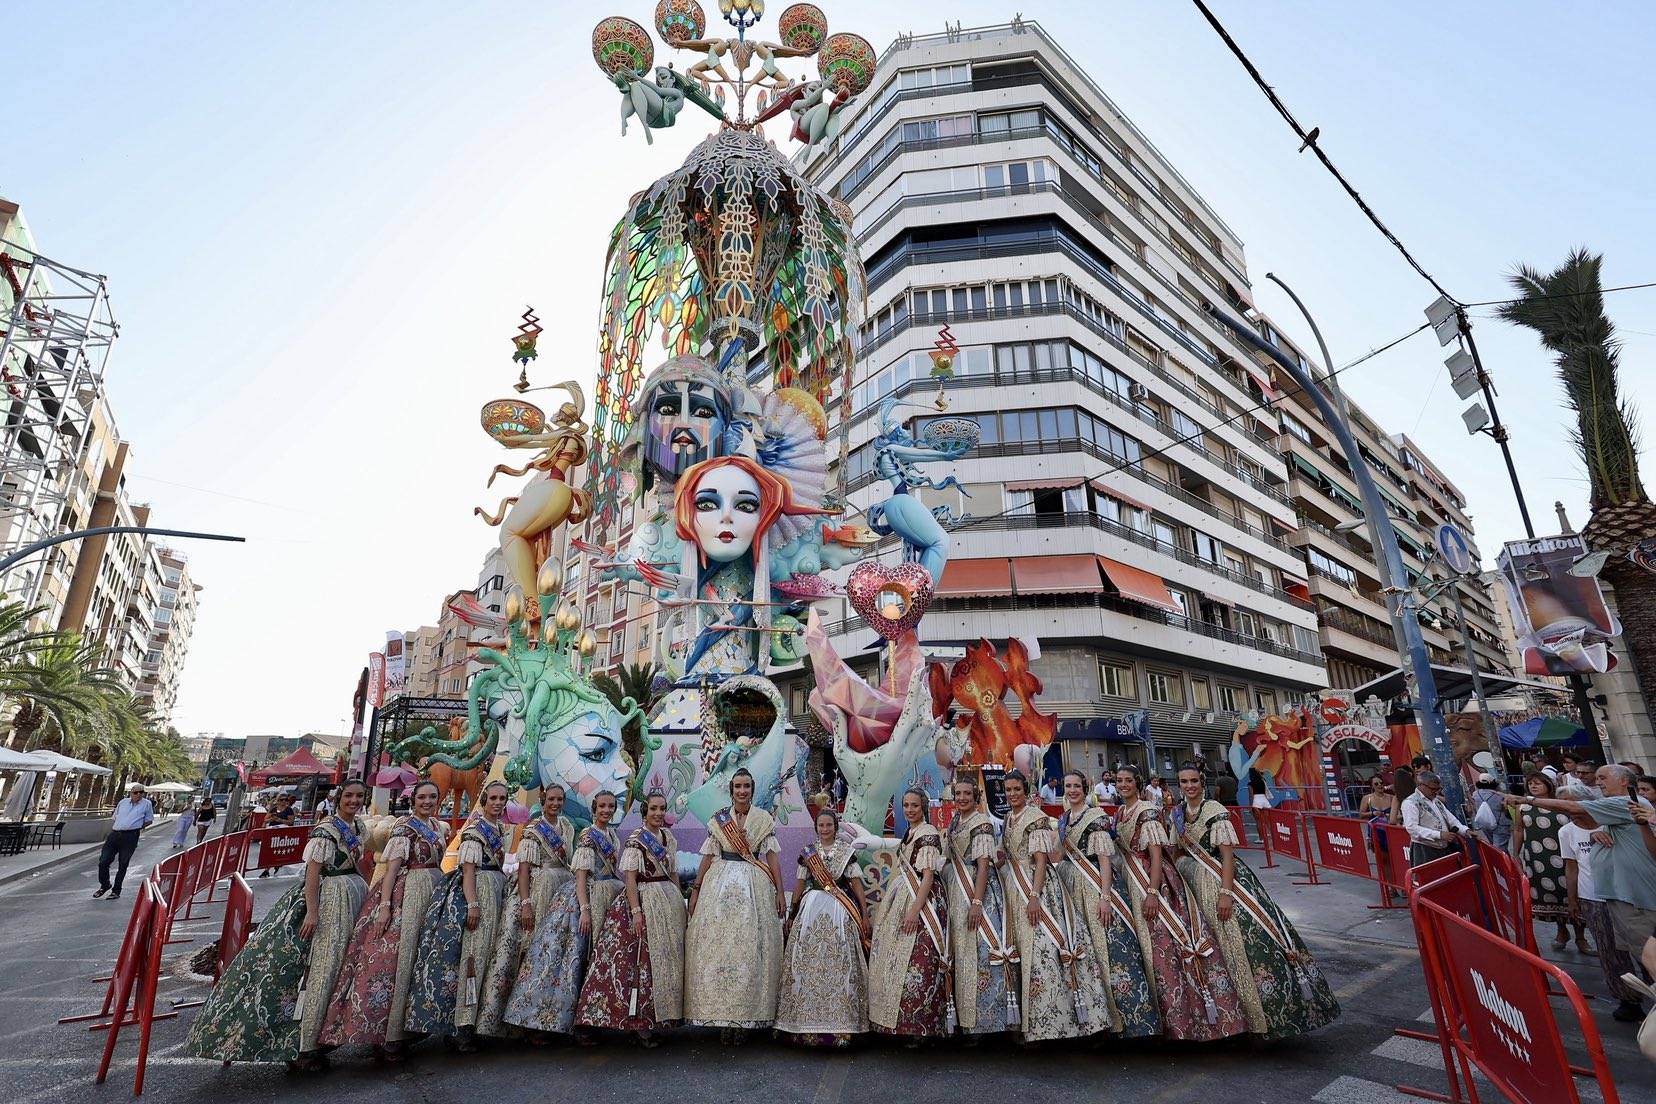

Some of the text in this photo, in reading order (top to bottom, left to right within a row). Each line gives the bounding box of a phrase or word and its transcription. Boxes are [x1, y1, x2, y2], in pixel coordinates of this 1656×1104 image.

[1509, 538, 1582, 557] Mahou
[270, 835, 300, 849] Mahou
[1328, 832, 1353, 848] Mahou
[1470, 967, 1532, 1044] Mahou
